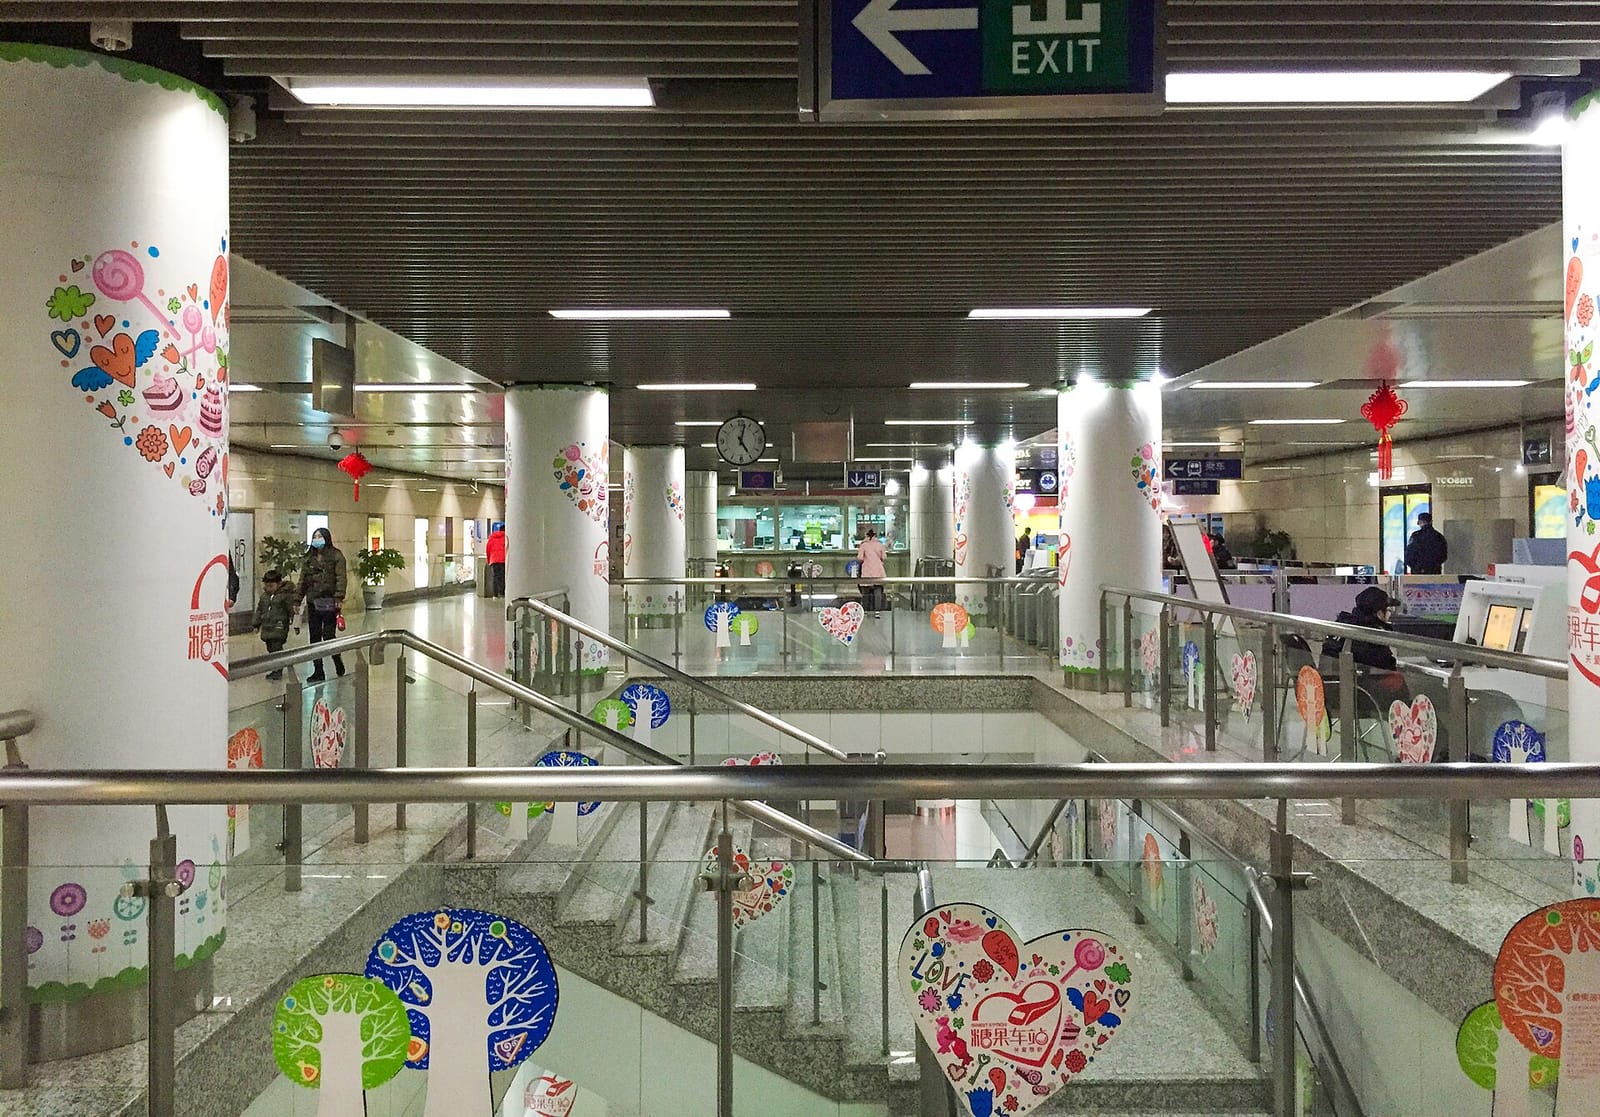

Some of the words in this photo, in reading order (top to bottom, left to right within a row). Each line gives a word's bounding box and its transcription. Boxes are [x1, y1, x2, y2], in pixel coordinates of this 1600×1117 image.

[1011, 38, 1101, 75] EXIT
[911, 949, 971, 996] LOVE
[971, 1028, 1049, 1049] 糖果车站
